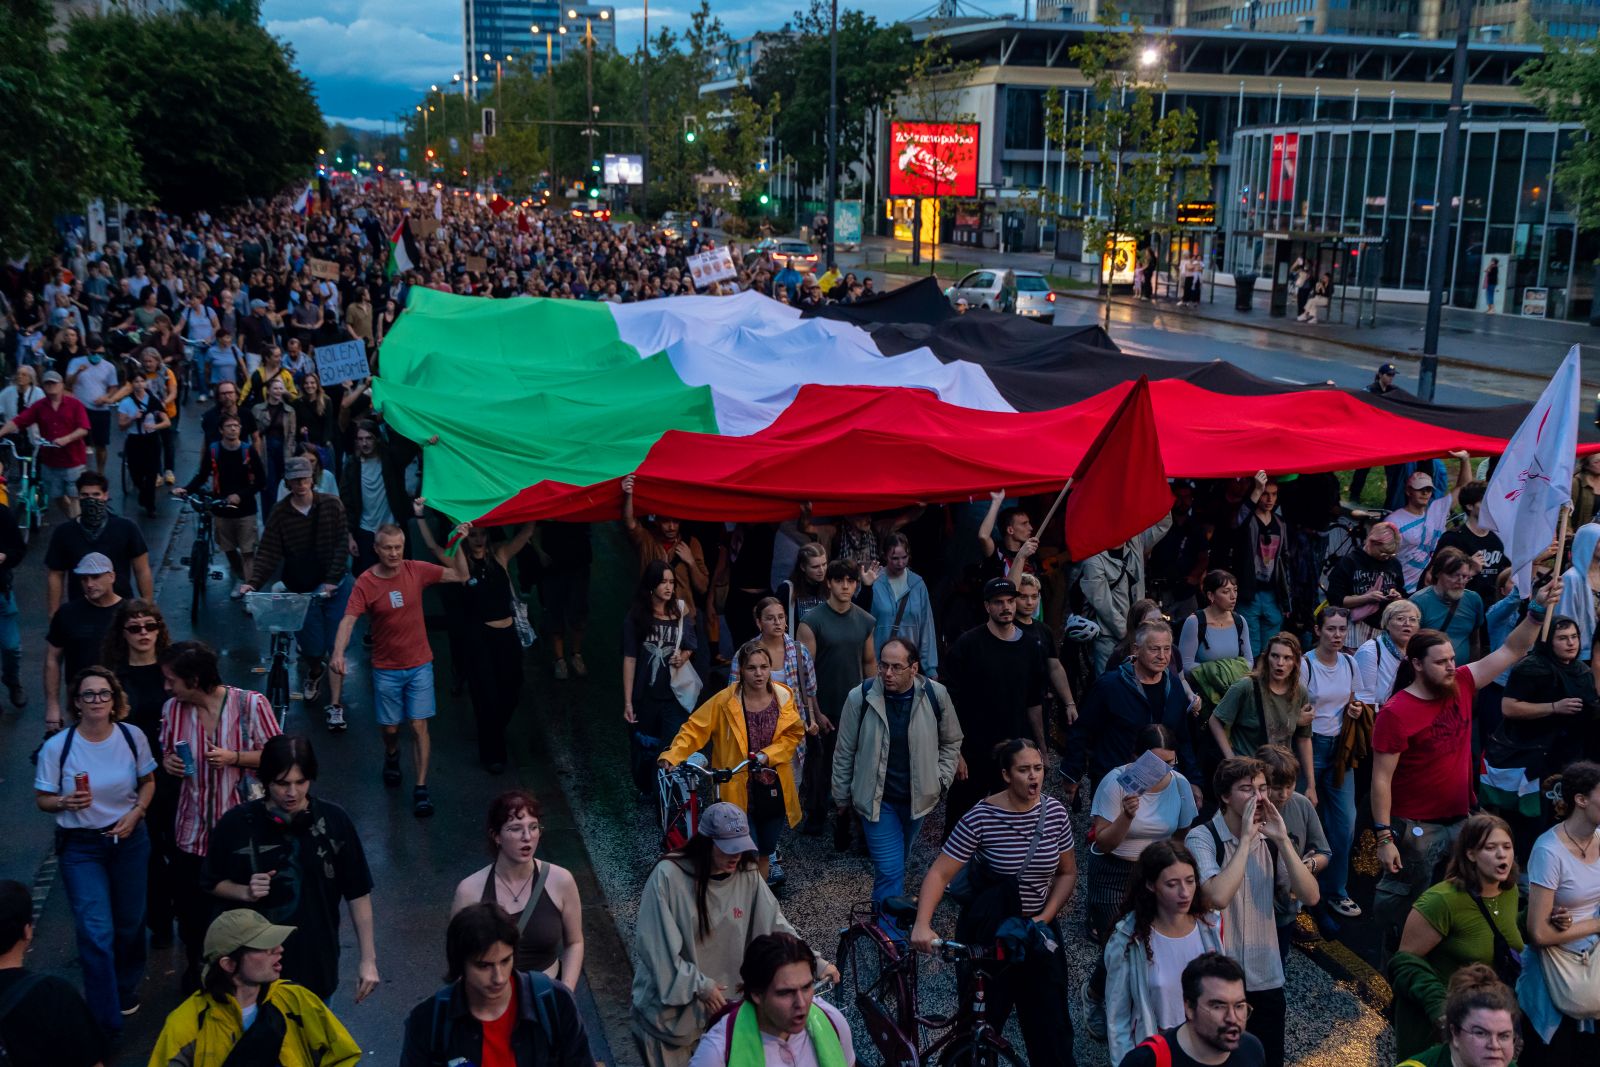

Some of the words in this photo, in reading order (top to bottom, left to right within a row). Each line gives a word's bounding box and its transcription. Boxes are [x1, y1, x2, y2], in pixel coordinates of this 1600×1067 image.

[319, 342, 361, 365] GOLEM
[320, 366, 335, 382] GO
[336, 360, 368, 377] HOME
